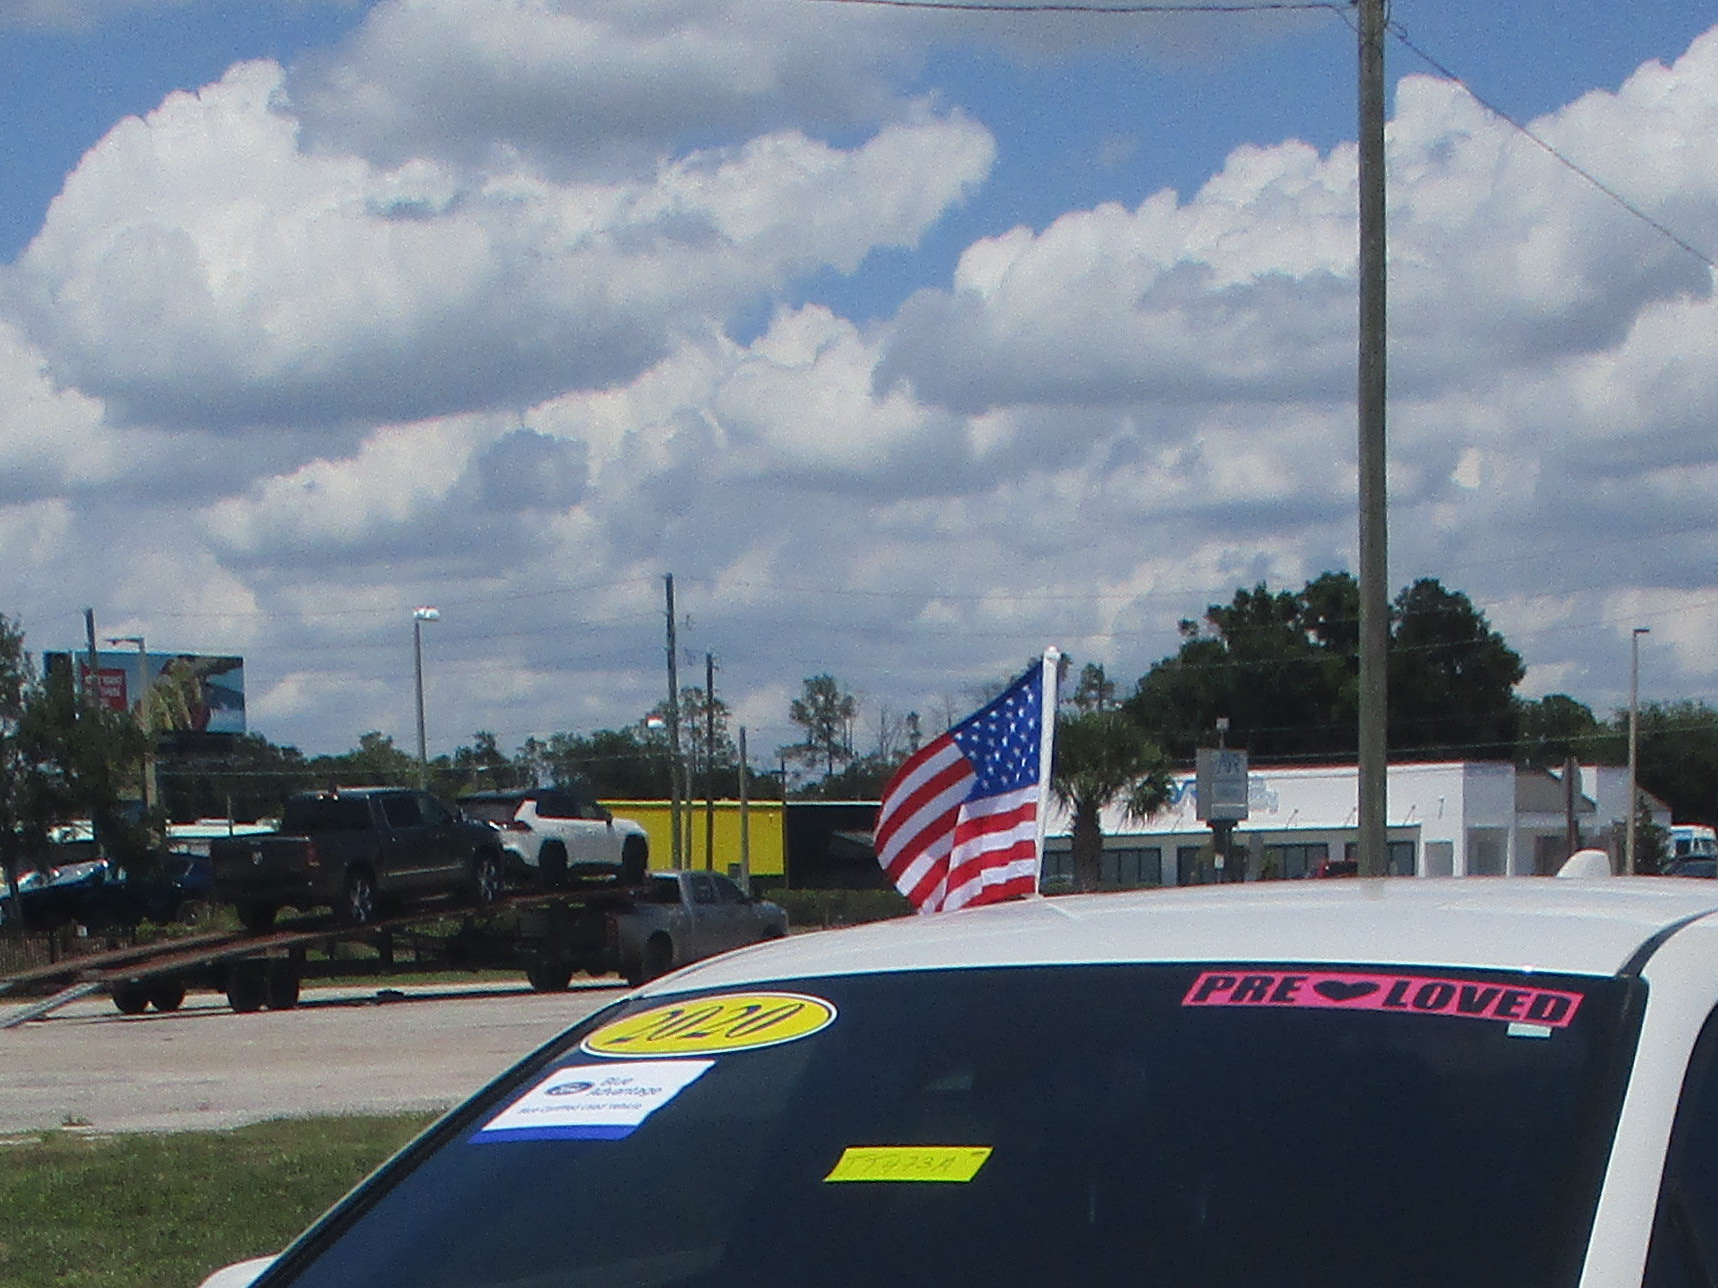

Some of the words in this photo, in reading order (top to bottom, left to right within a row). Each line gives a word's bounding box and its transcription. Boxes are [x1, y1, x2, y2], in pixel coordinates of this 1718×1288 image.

[1191, 975, 1308, 1003] PRE
[1383, 979, 1573, 1021] LOVED
[605, 1002, 806, 1045] 2020
